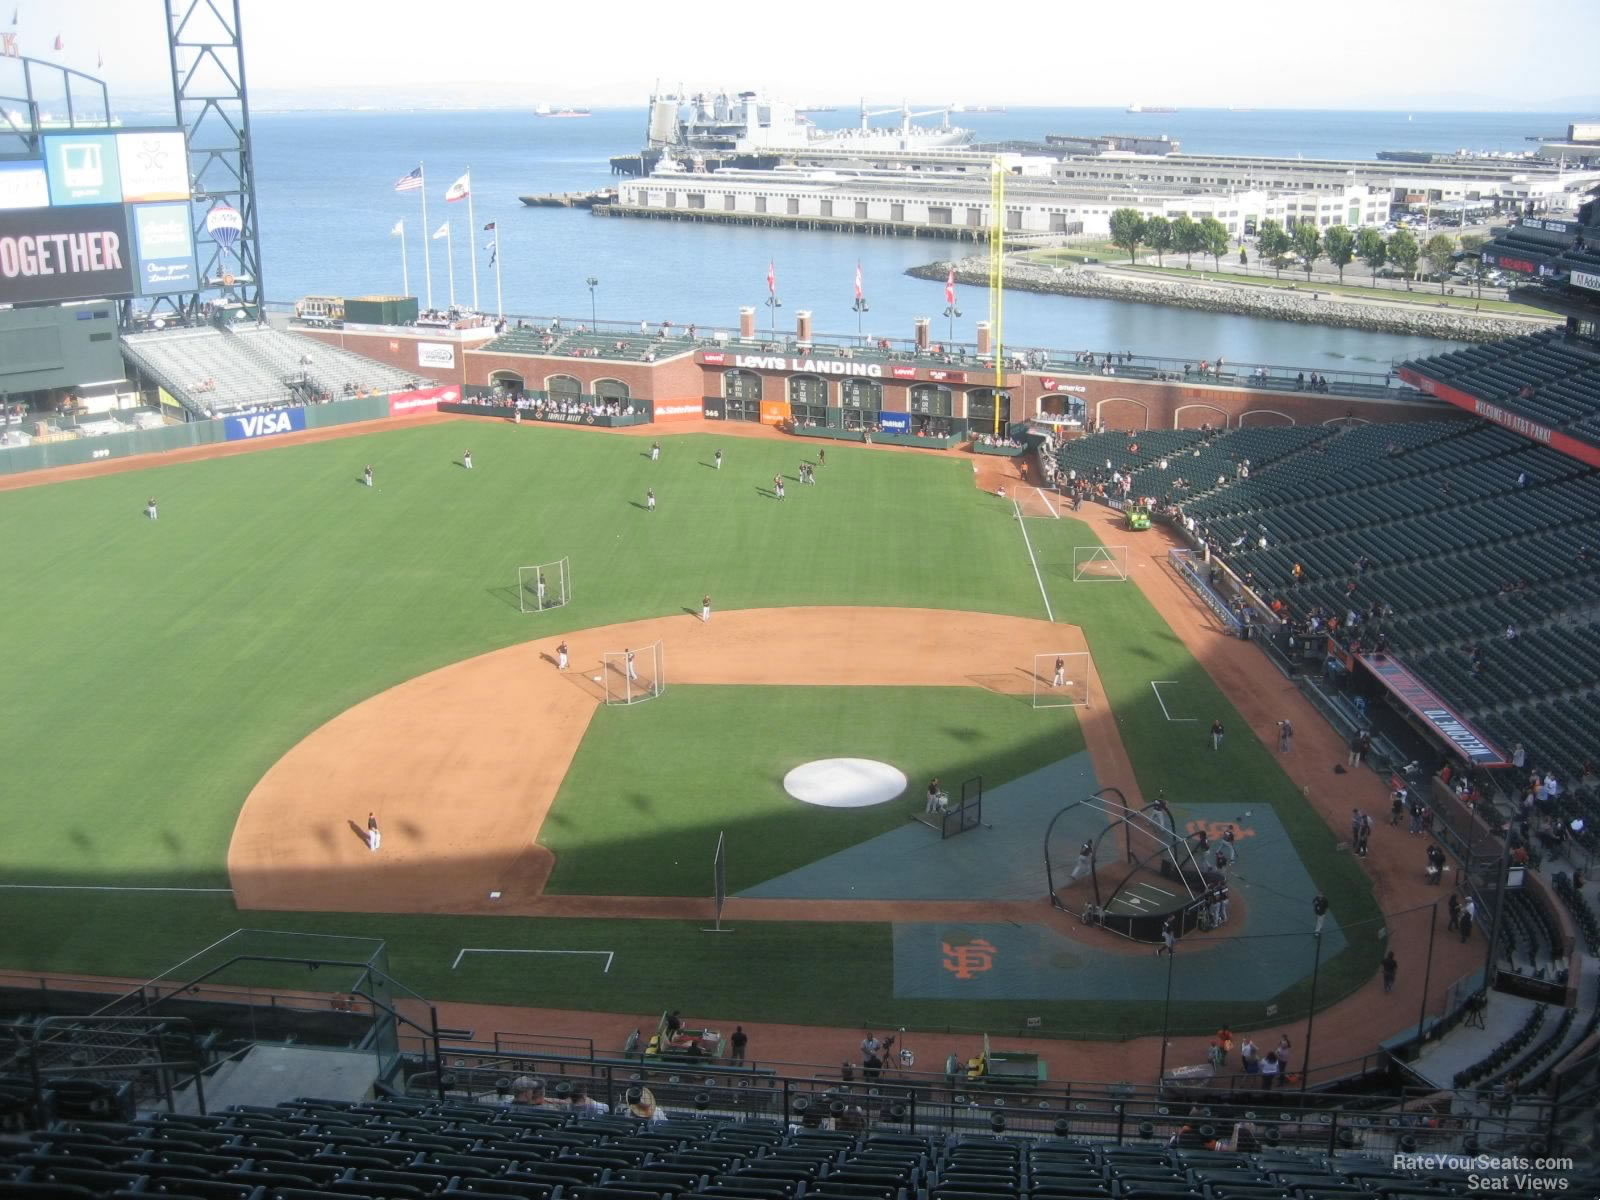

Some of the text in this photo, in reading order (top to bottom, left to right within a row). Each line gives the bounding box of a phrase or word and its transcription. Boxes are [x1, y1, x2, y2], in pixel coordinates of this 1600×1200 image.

[792, 358, 882, 377] LANDING
[567, 415, 582, 423] ALLEY
[705, 409, 719, 417] 365
[1475, 399, 1552, 443] WELCOME TO AT&T PARK!
[237, 412, 292, 437] VISA
[93, 449, 110, 458] 399
[1436, 720, 1492, 756] WELCOME
